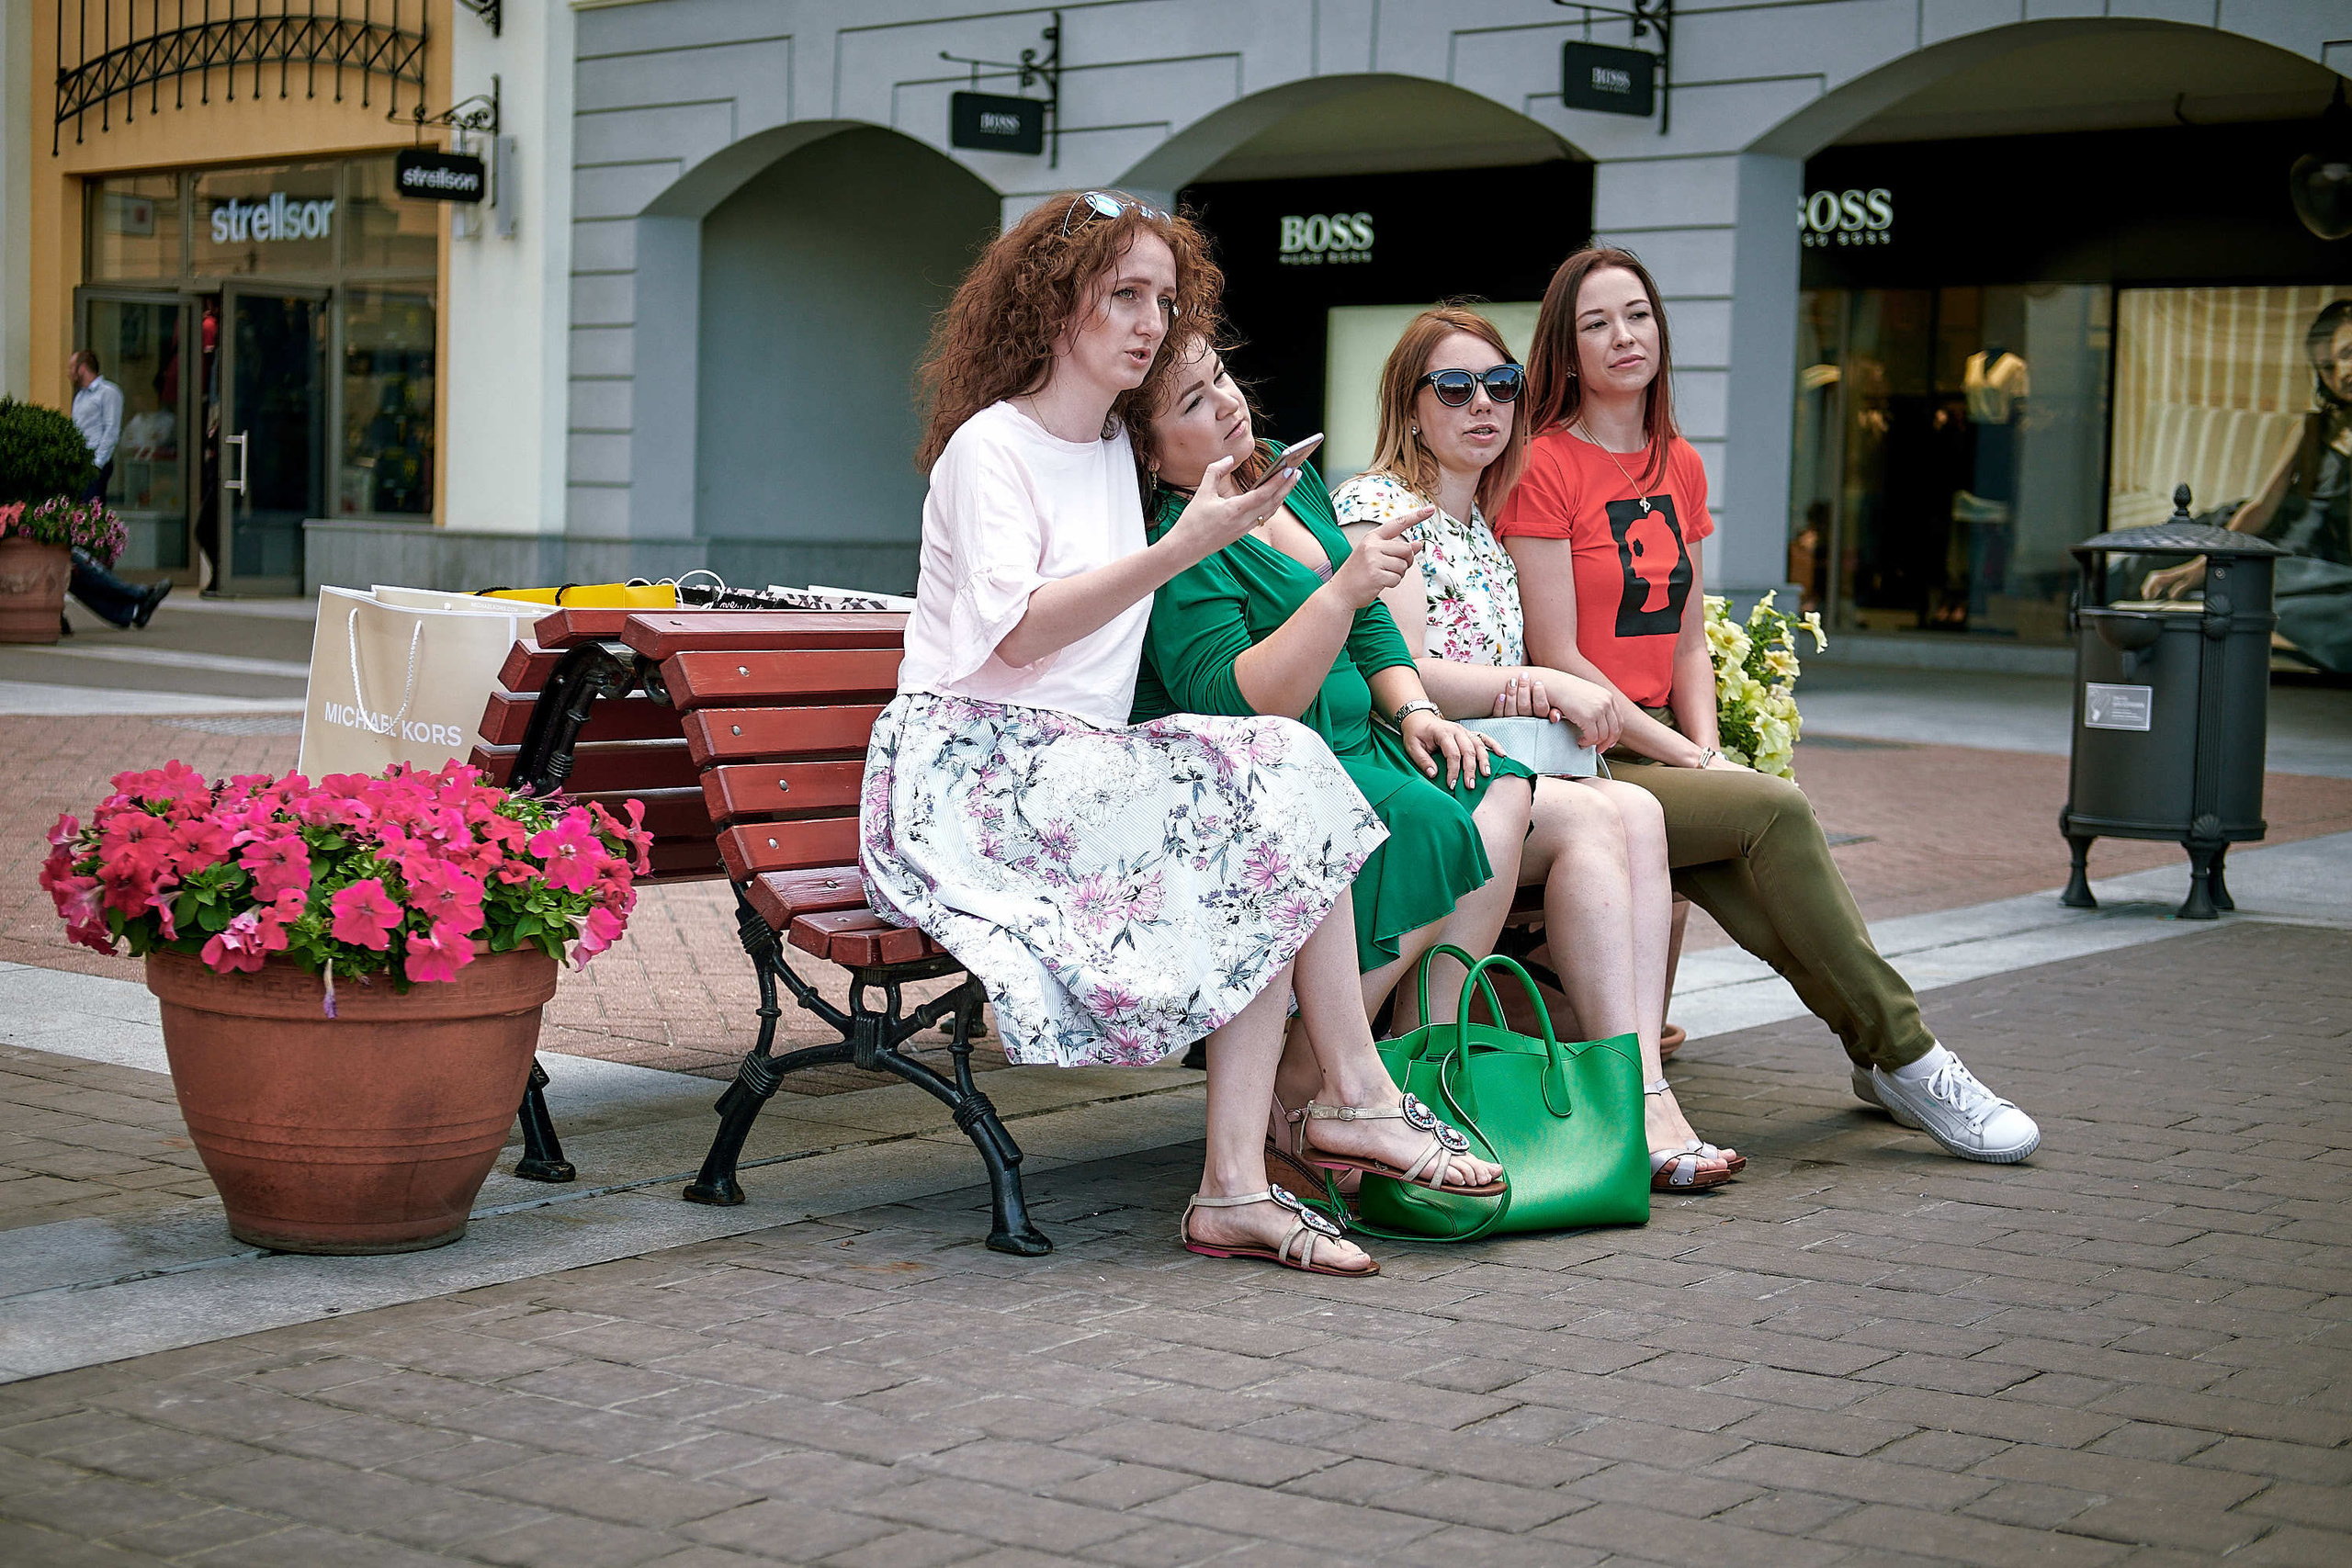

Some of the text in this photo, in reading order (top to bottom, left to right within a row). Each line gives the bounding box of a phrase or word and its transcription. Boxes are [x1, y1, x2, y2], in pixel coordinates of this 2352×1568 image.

[402, 165, 479, 192] strellson
[1279, 211, 1375, 253] BOSS
[401, 719, 463, 747] KORS
